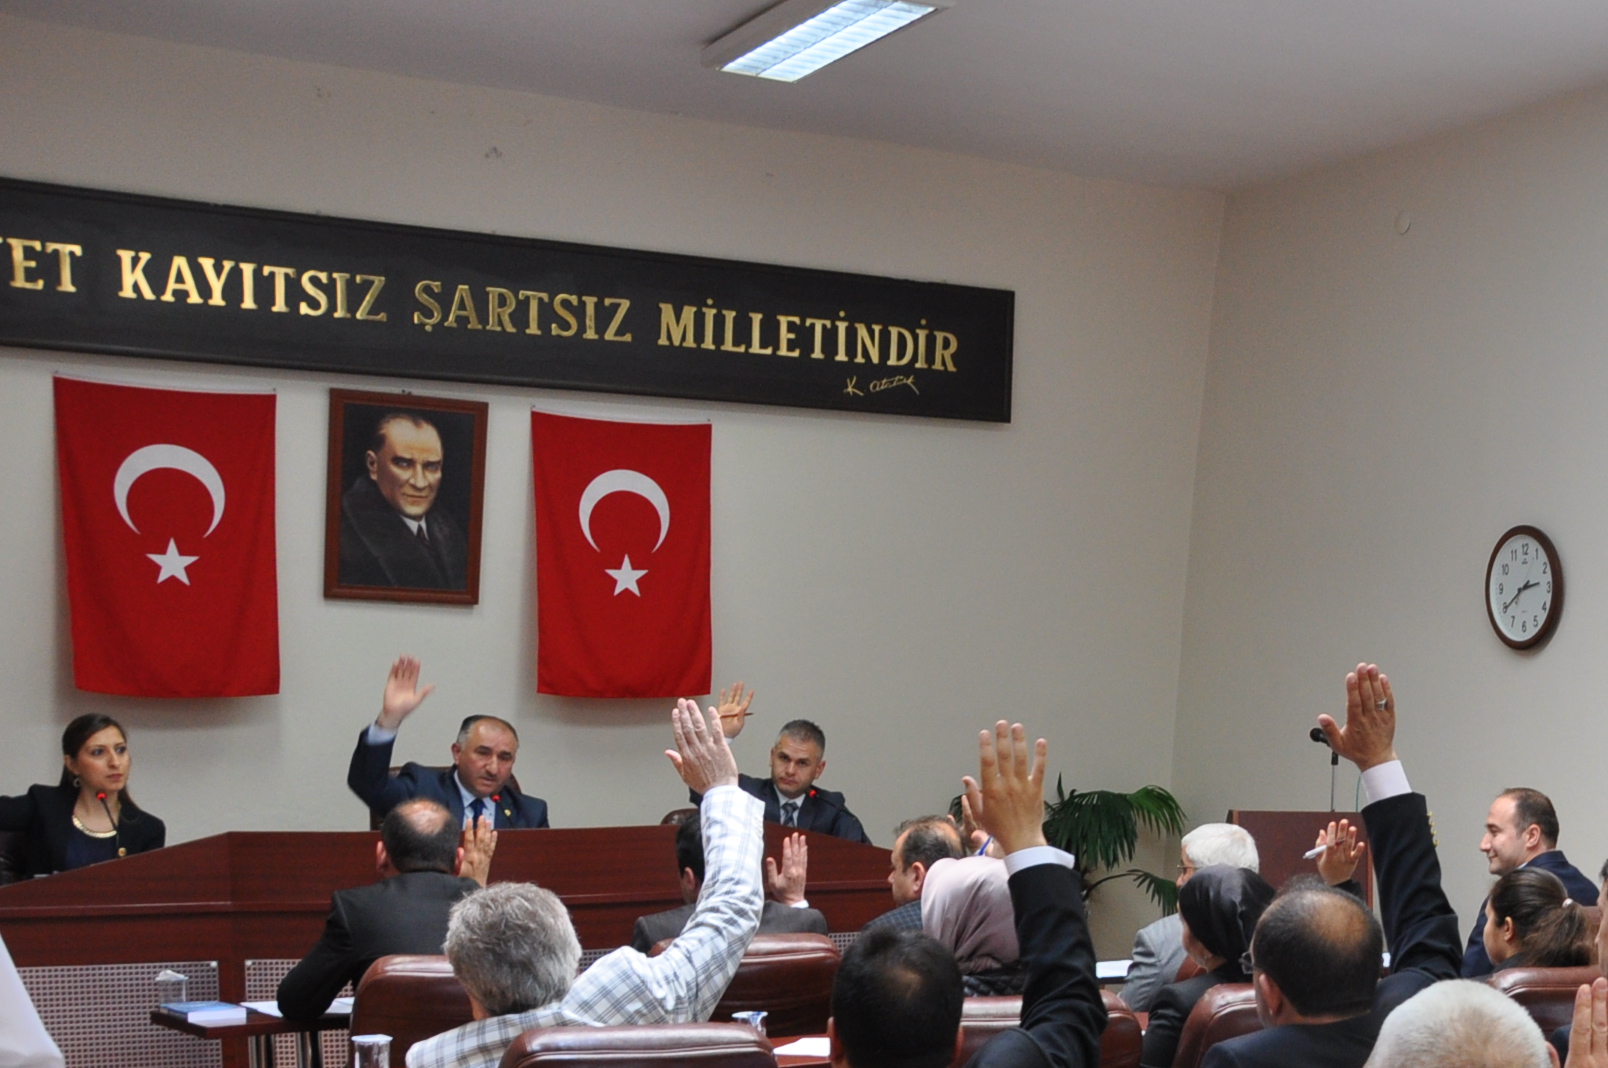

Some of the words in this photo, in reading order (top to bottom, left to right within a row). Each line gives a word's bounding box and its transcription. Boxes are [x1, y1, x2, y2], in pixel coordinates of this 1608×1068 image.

[0, 236, 83, 293] ET
[115, 248, 388, 323] KAYITSIZ
[413, 279, 632, 343] ŞARTSIZ
[657, 298, 959, 373] MİLLETİNDİR
[1510, 549, 1518, 561] 11
[1521, 543, 1529, 556] 12
[1535, 547, 1540, 560] 1
[1501, 563, 1509, 576] 10
[1542, 561, 1548, 575] 2
[1498, 583, 1504, 595] 9
[1546, 581, 1551, 594] 3
[1541, 601, 1547, 613] 4
[1511, 615, 1516, 628] 7
[1521, 621, 1527, 633] 6
[1533, 615, 1539, 628] 5
